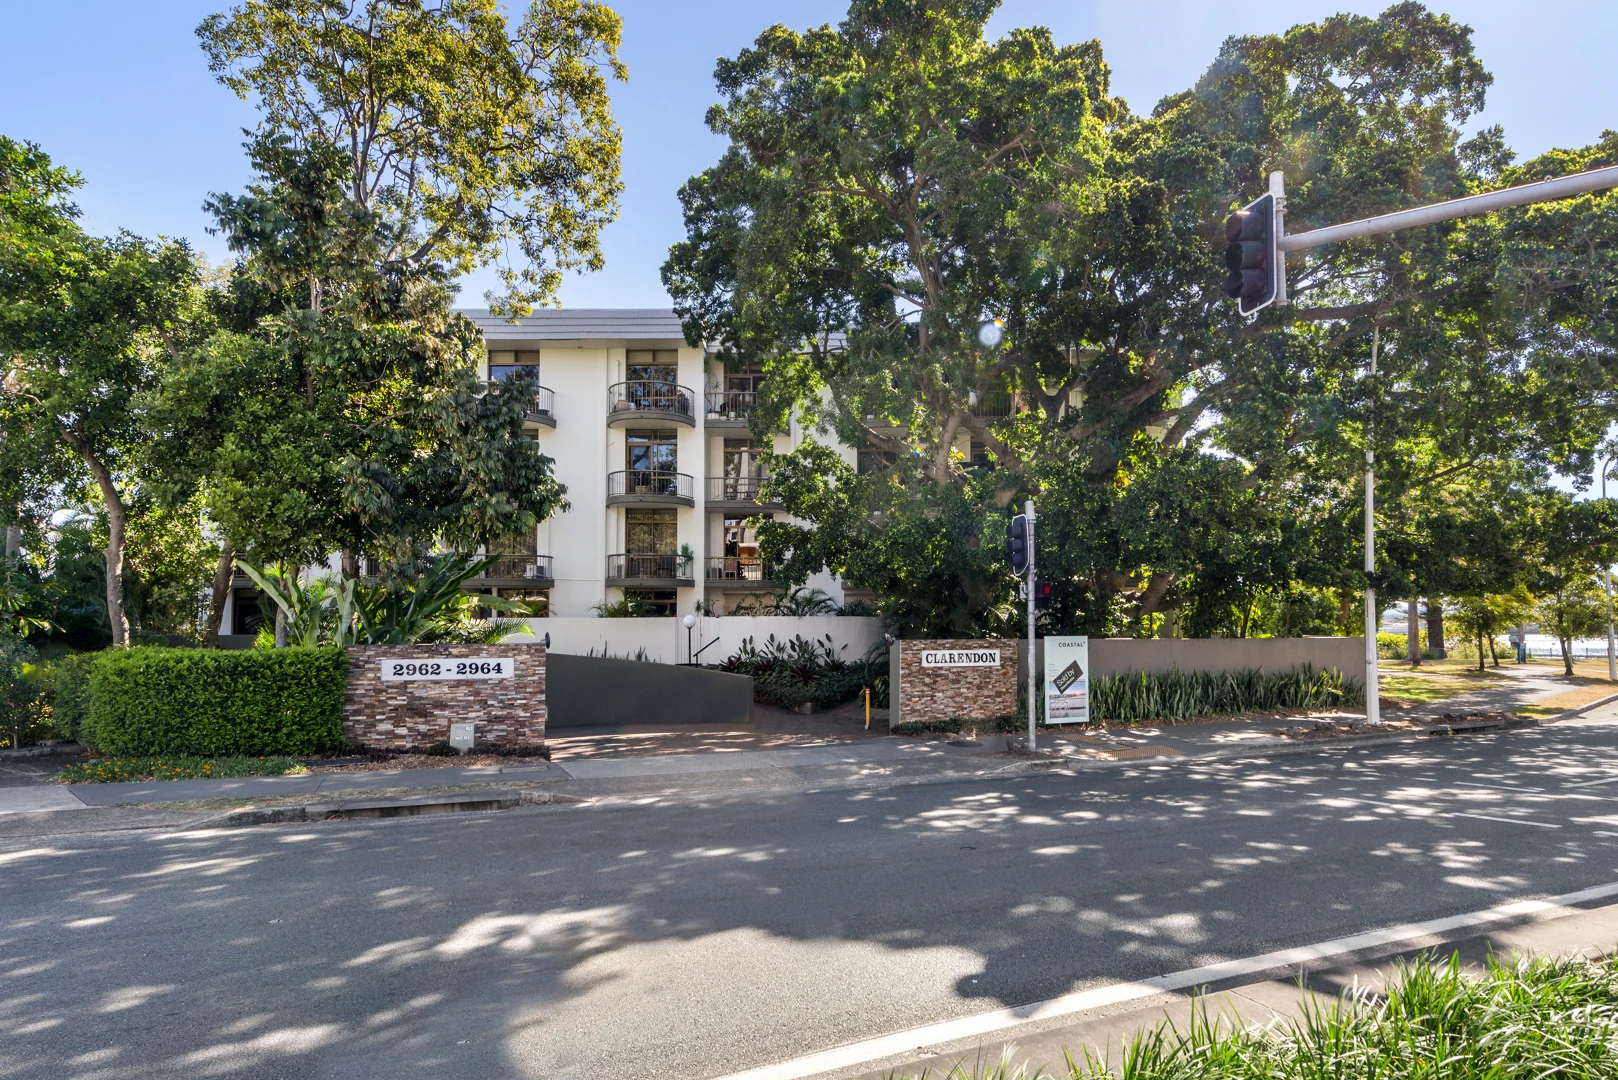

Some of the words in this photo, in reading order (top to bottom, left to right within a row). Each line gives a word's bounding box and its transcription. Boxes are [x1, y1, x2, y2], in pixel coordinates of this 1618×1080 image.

[926, 653, 996, 663] CLARENDON
[393, 663, 441, 676] 2962
[456, 662, 502, 675] 2964
[1056, 672, 1069, 687] Sold
[1066, 668, 1075, 677] by
